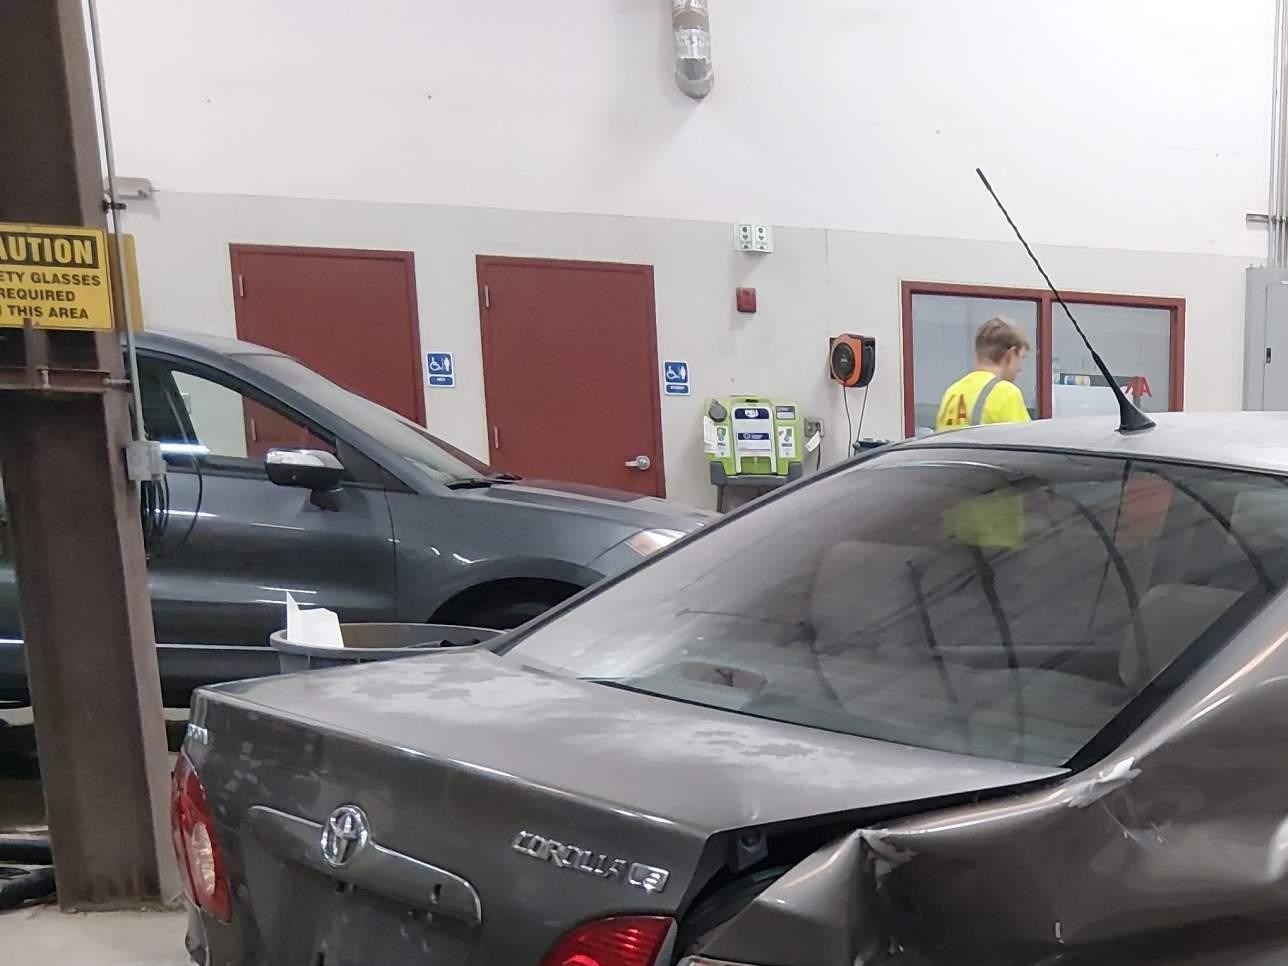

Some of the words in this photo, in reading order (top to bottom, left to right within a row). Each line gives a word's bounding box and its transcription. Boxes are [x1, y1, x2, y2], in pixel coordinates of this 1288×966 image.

[31, 272, 101, 286] GLASSES
[7, 305, 43, 317] THIS
[48, 307, 89, 319] AREA
[513, 831, 627, 880] COROLLA
